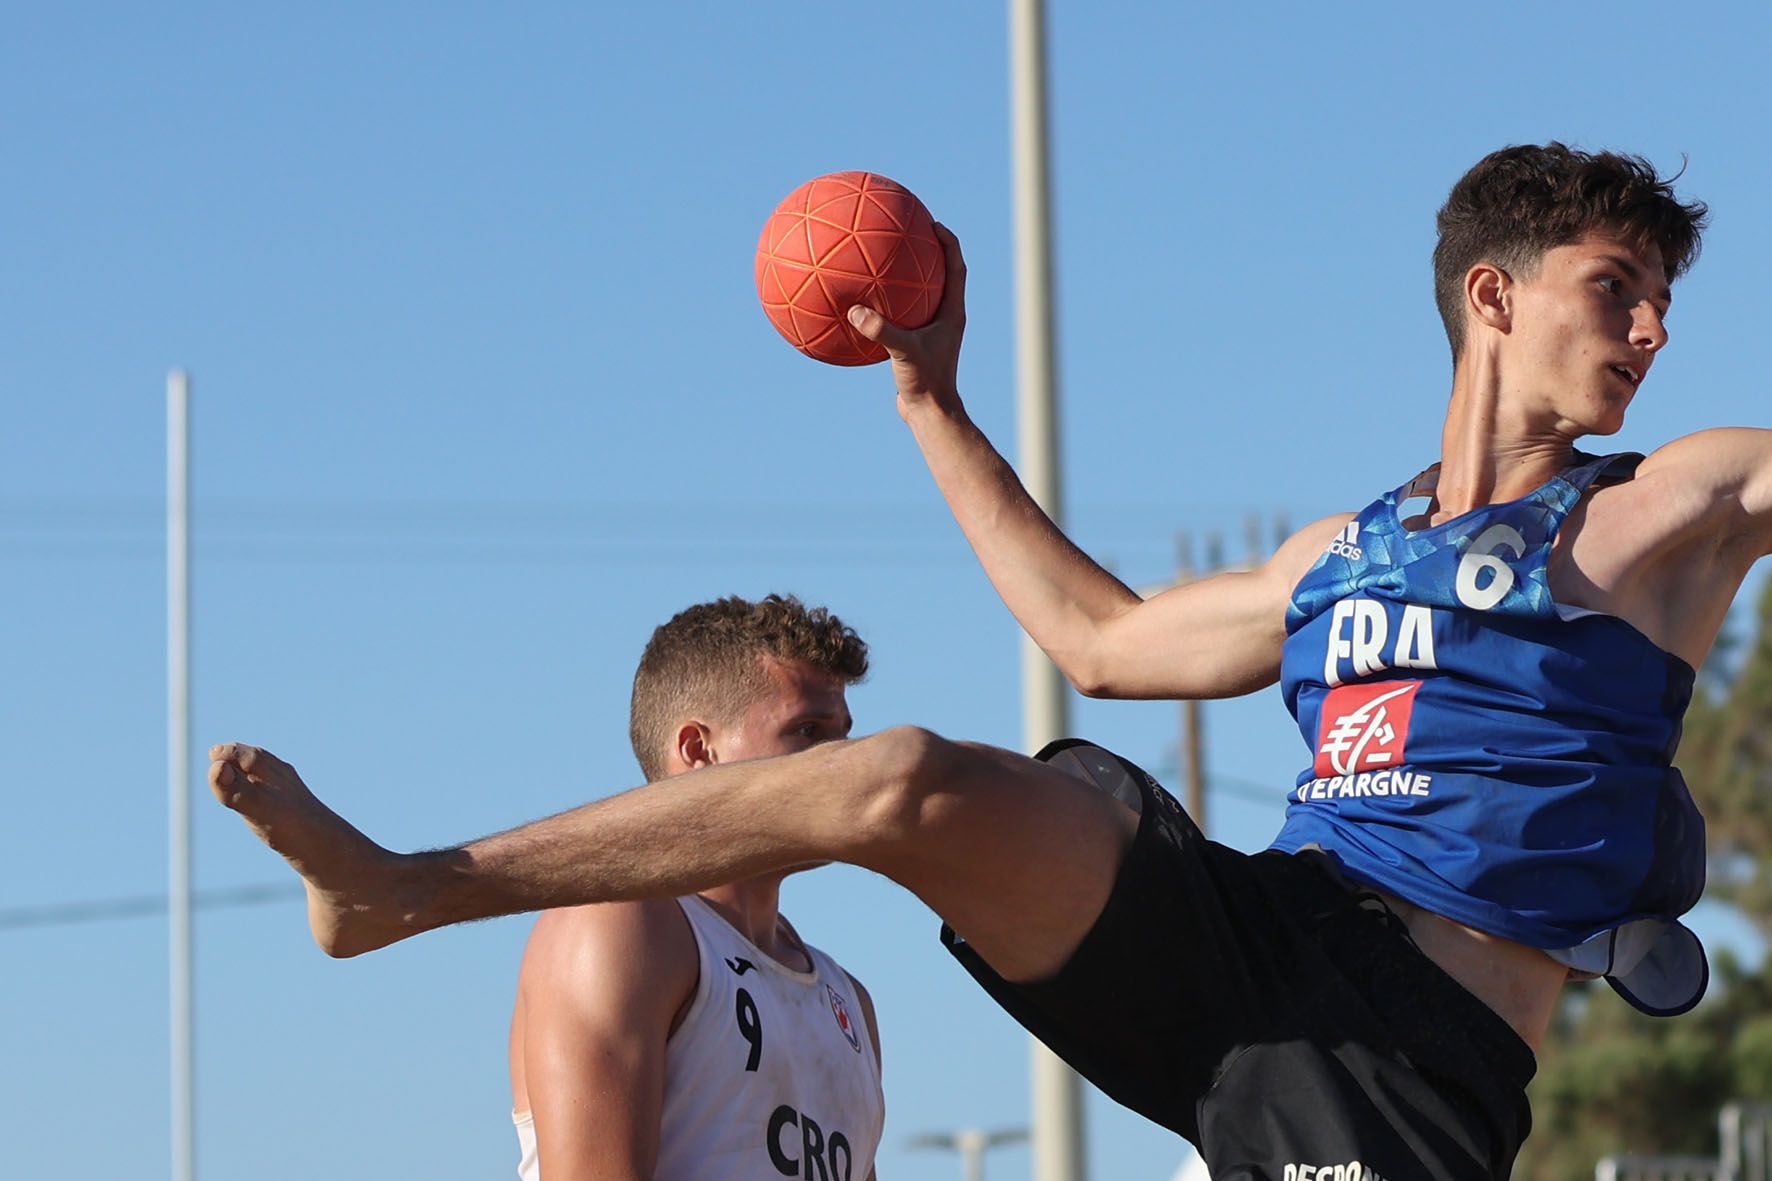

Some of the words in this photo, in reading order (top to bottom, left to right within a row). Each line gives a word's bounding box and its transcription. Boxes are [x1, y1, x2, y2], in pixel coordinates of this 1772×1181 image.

[1455, 523, 1527, 611] 6
[1324, 599, 1439, 688] FRA
[736, 987, 763, 1073] 9
